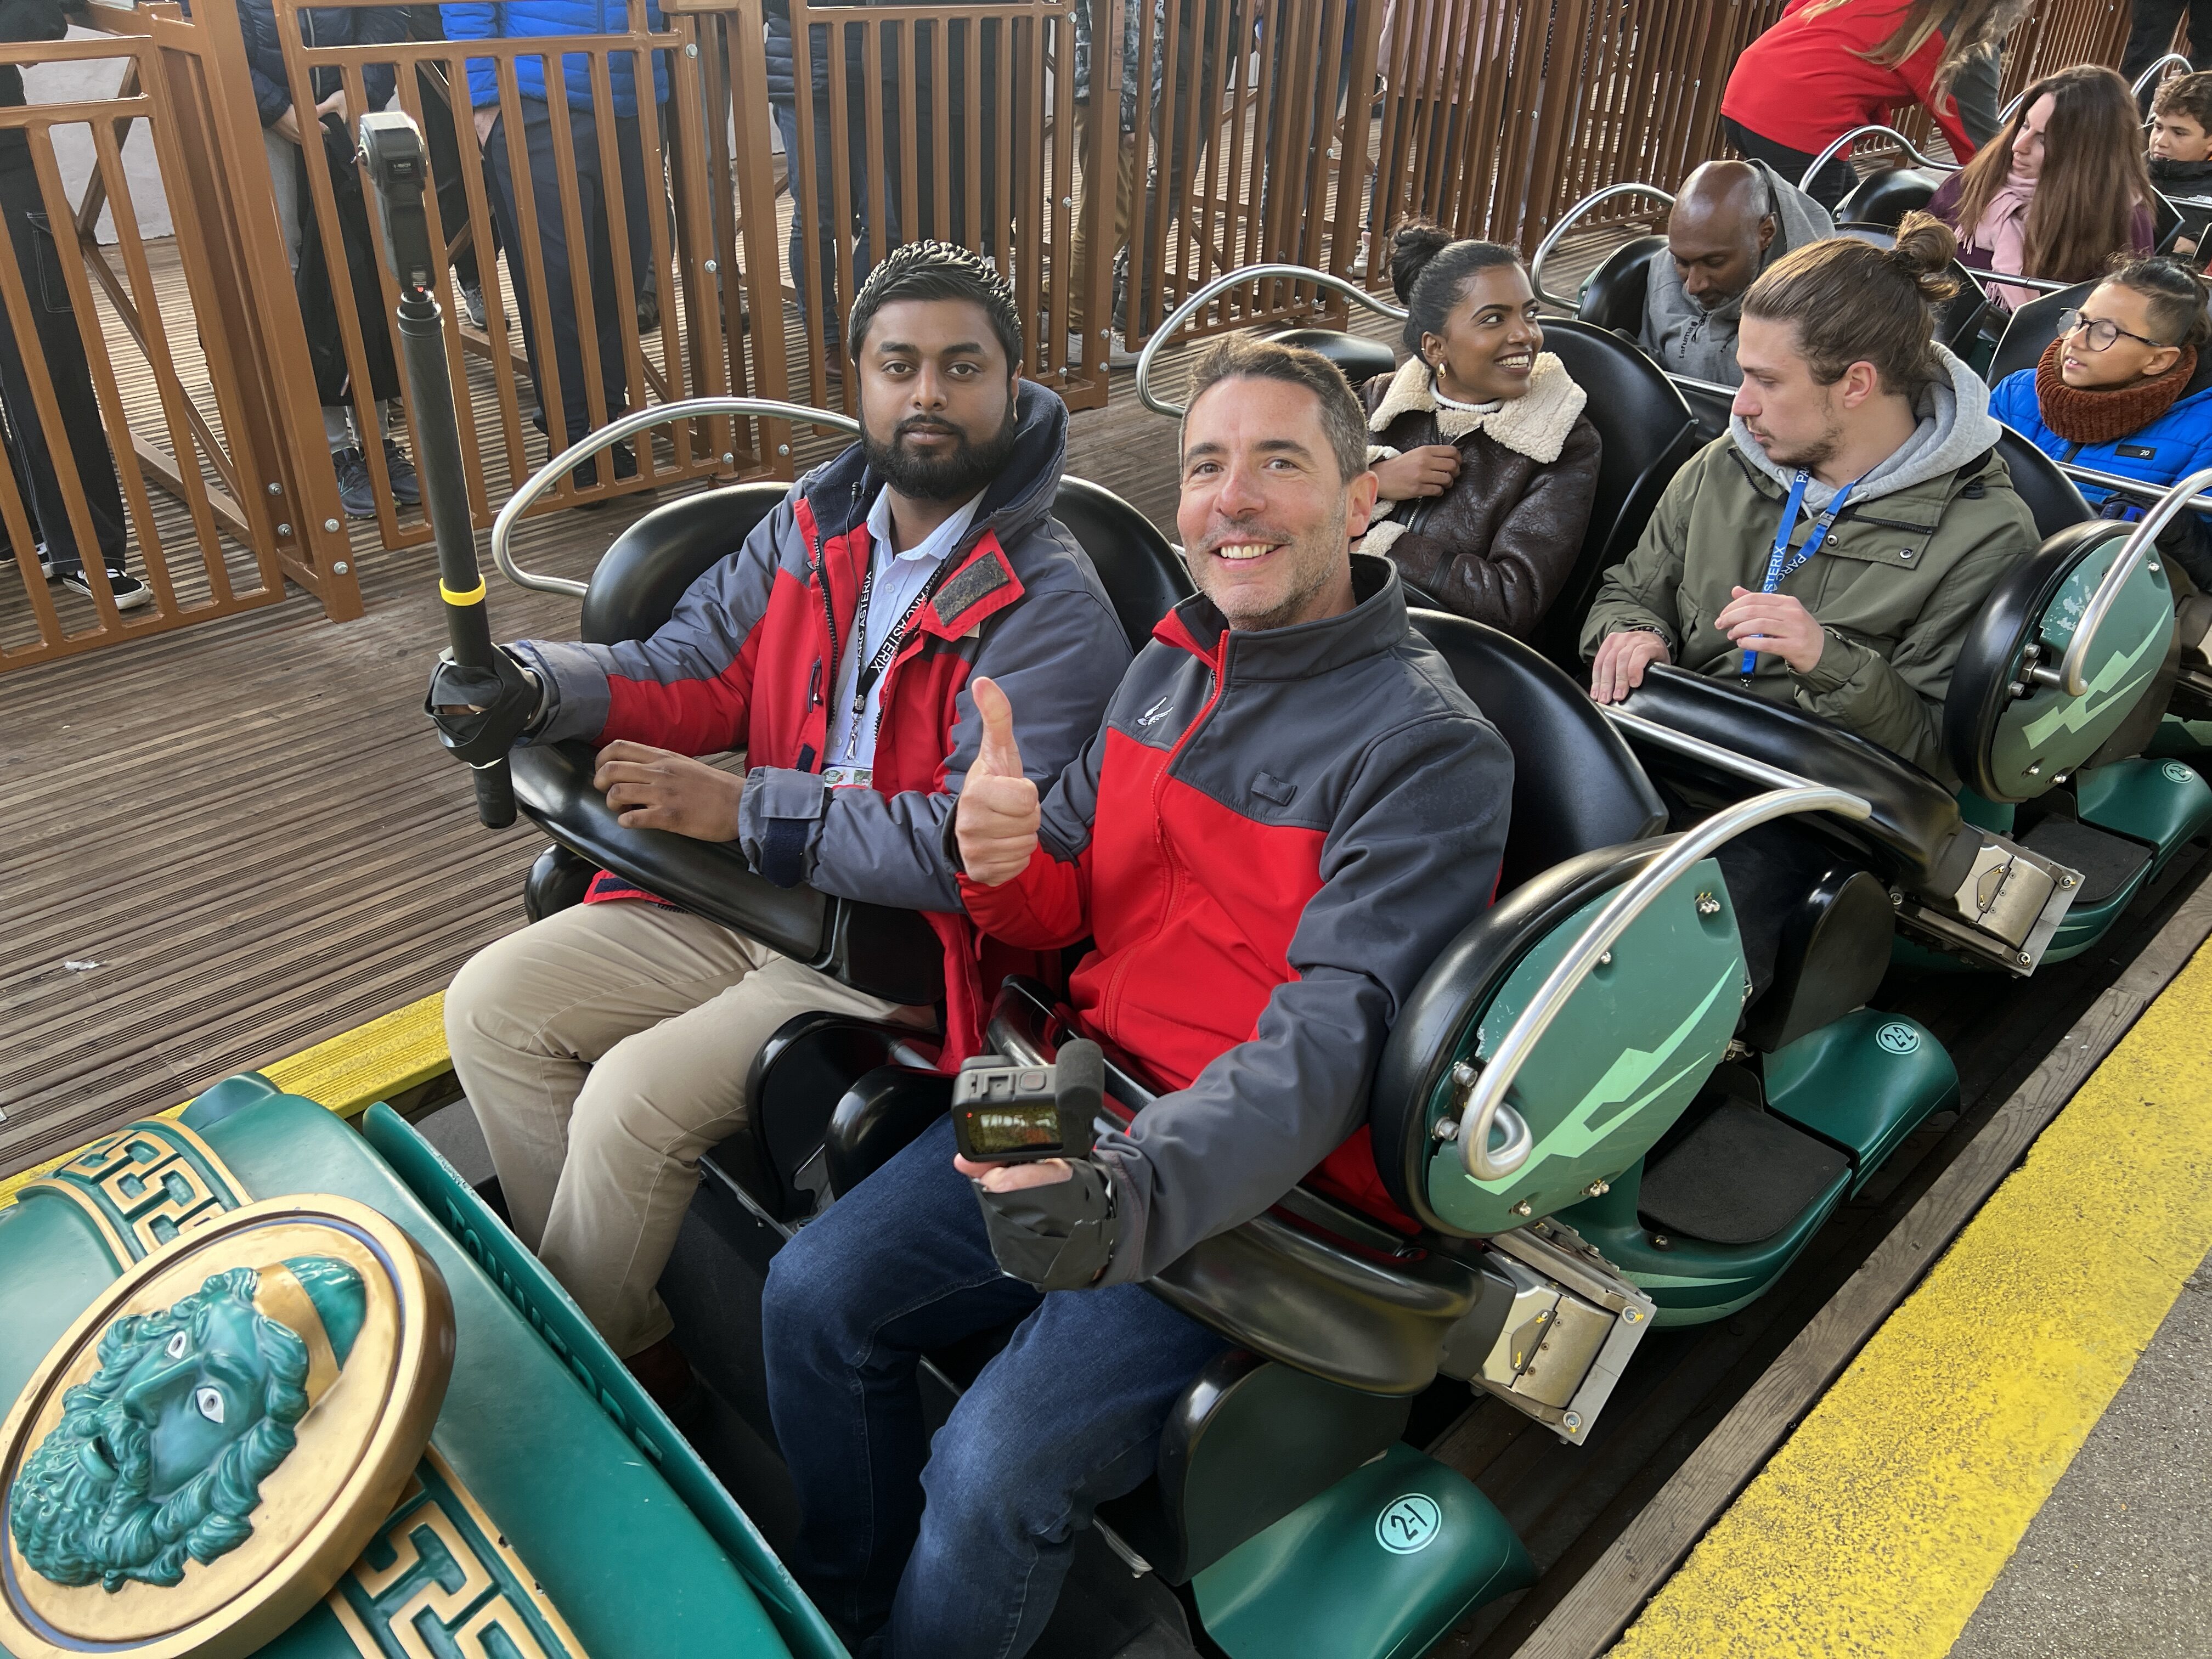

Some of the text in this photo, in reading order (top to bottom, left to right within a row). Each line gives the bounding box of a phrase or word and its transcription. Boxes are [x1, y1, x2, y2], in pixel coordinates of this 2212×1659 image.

[1679, 326, 1694, 358] Lafuma
[1763, 546, 1785, 592] STERIX
[1776, 553, 1807, 582] PARC
[859, 571, 872, 627] ASTERIX
[1884, 1026, 1914, 1048] 2-2
[1391, 1503, 1427, 1541] 2-1
